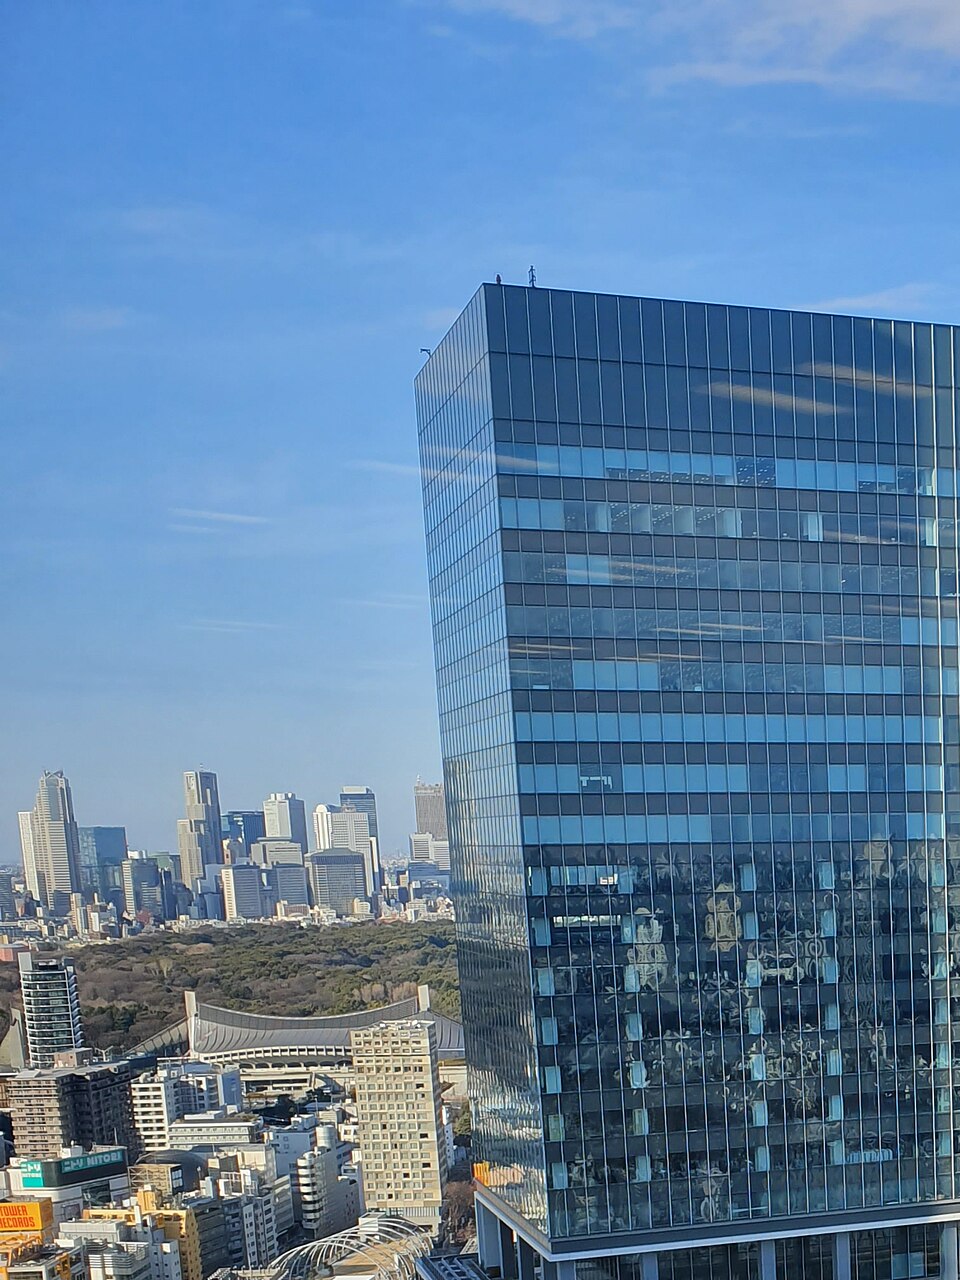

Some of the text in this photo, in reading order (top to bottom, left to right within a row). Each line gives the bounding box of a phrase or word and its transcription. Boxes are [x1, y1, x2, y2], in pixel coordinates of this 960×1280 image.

[64, 1151, 121, 1172] ニトリ NITORI
